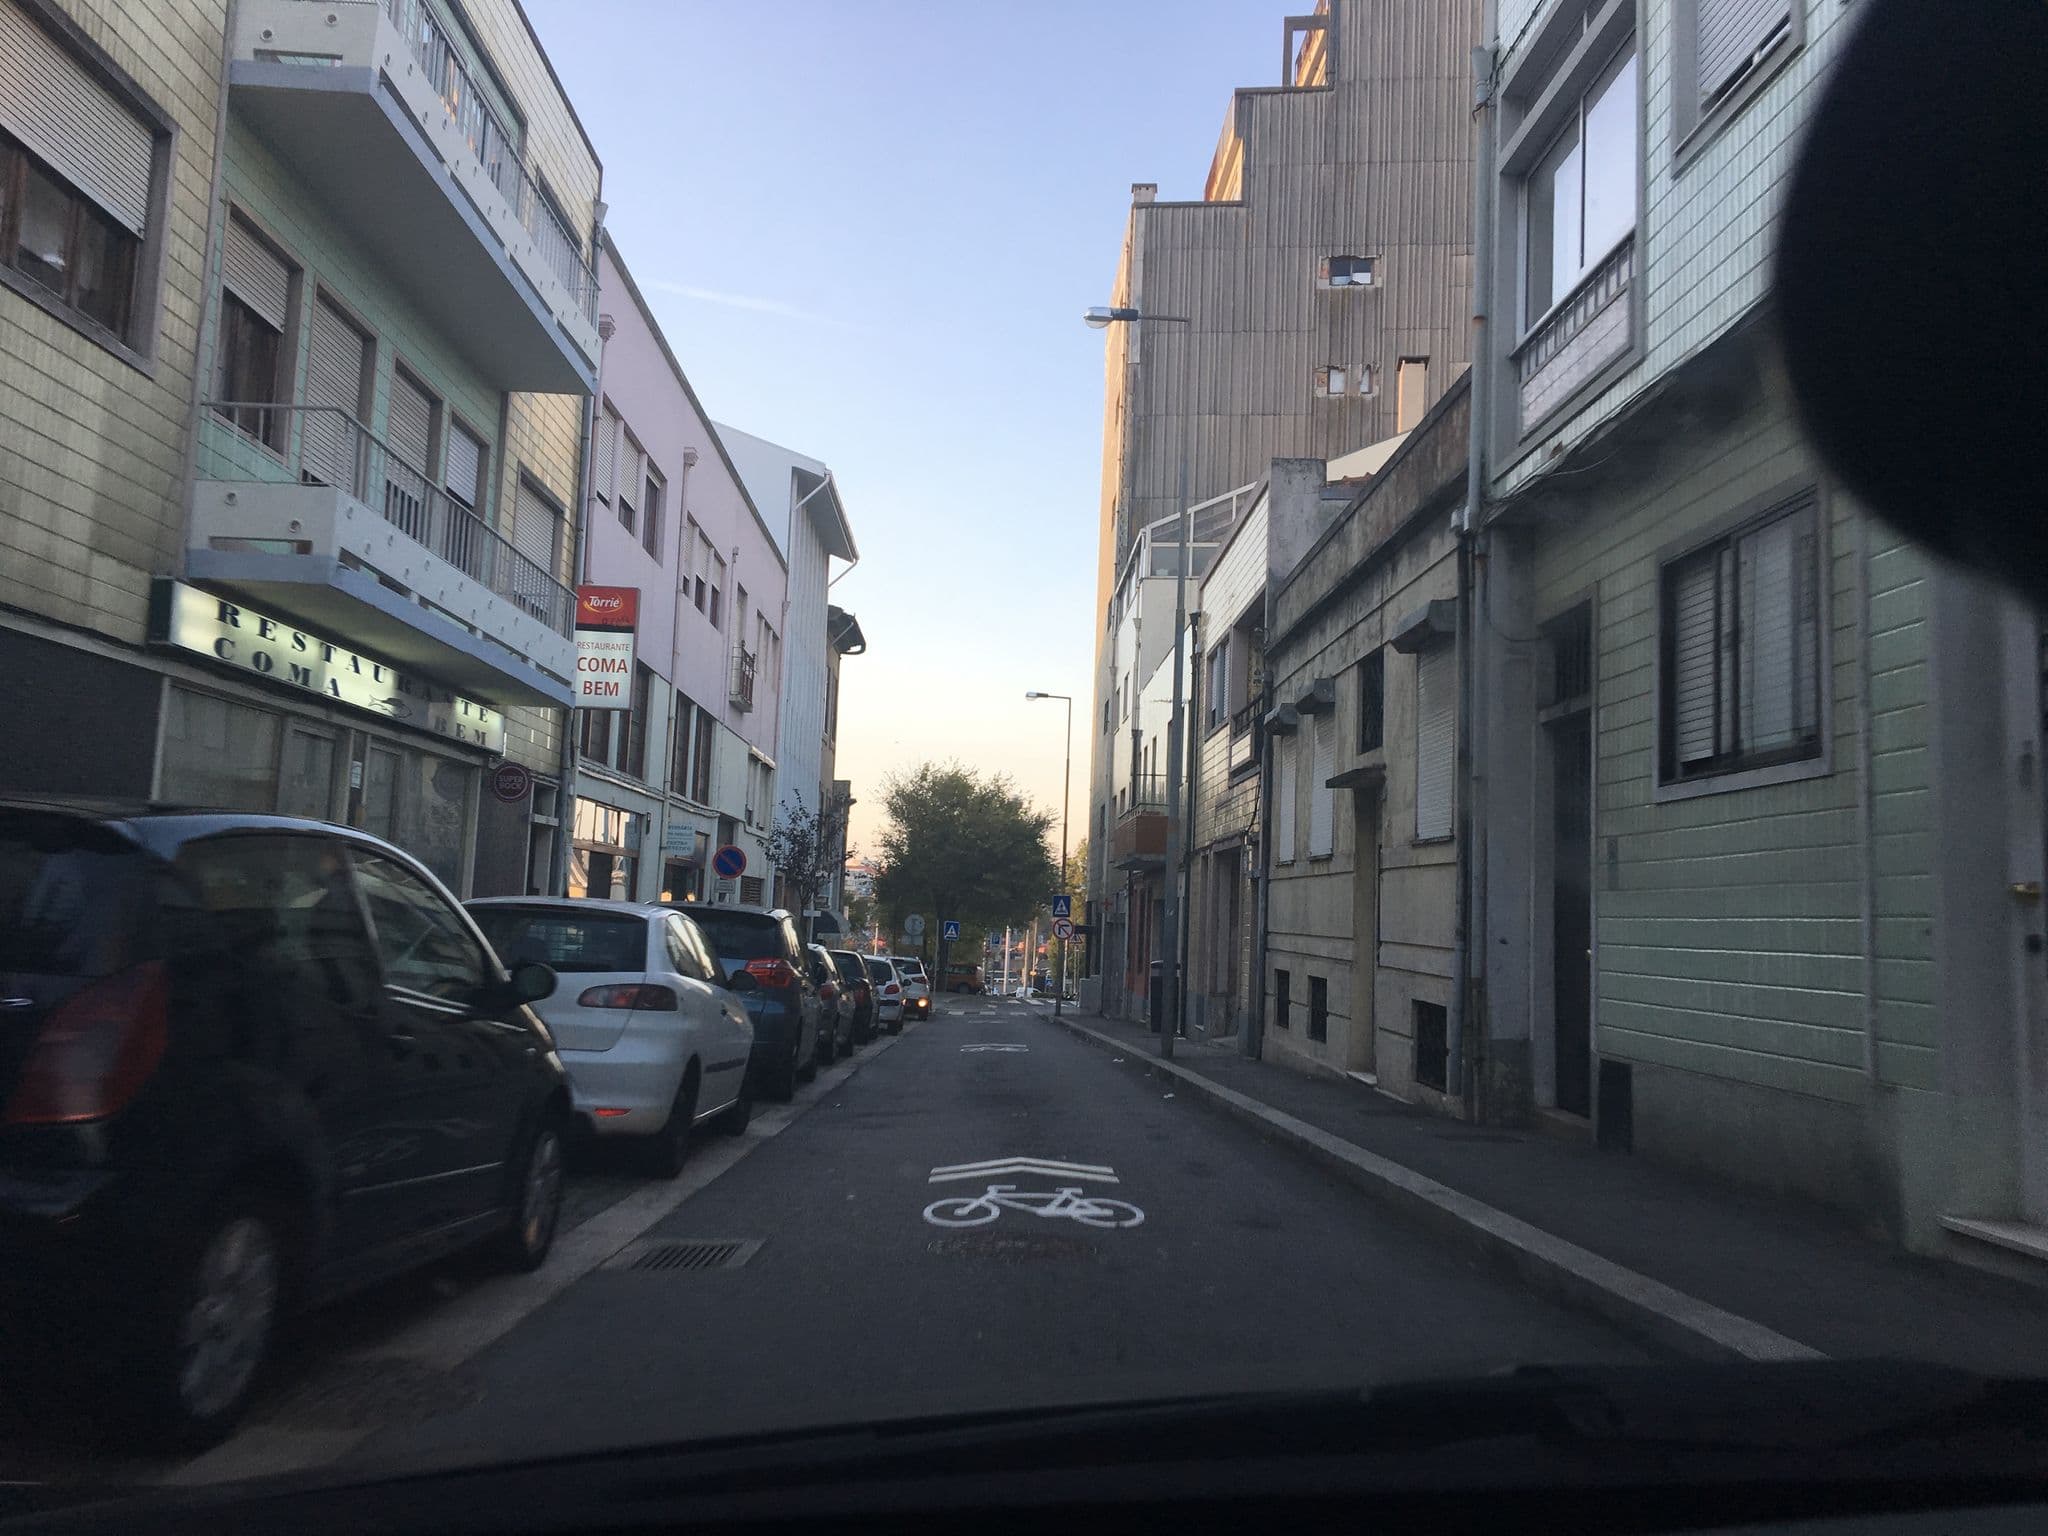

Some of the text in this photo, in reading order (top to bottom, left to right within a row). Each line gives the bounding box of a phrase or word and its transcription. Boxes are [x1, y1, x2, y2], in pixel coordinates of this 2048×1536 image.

[577, 640, 630, 651] RESTAURANTE
[577, 657, 628, 673] COMA
[213, 637, 487, 746] COMA BEM
[583, 680, 619, 696] BEM
